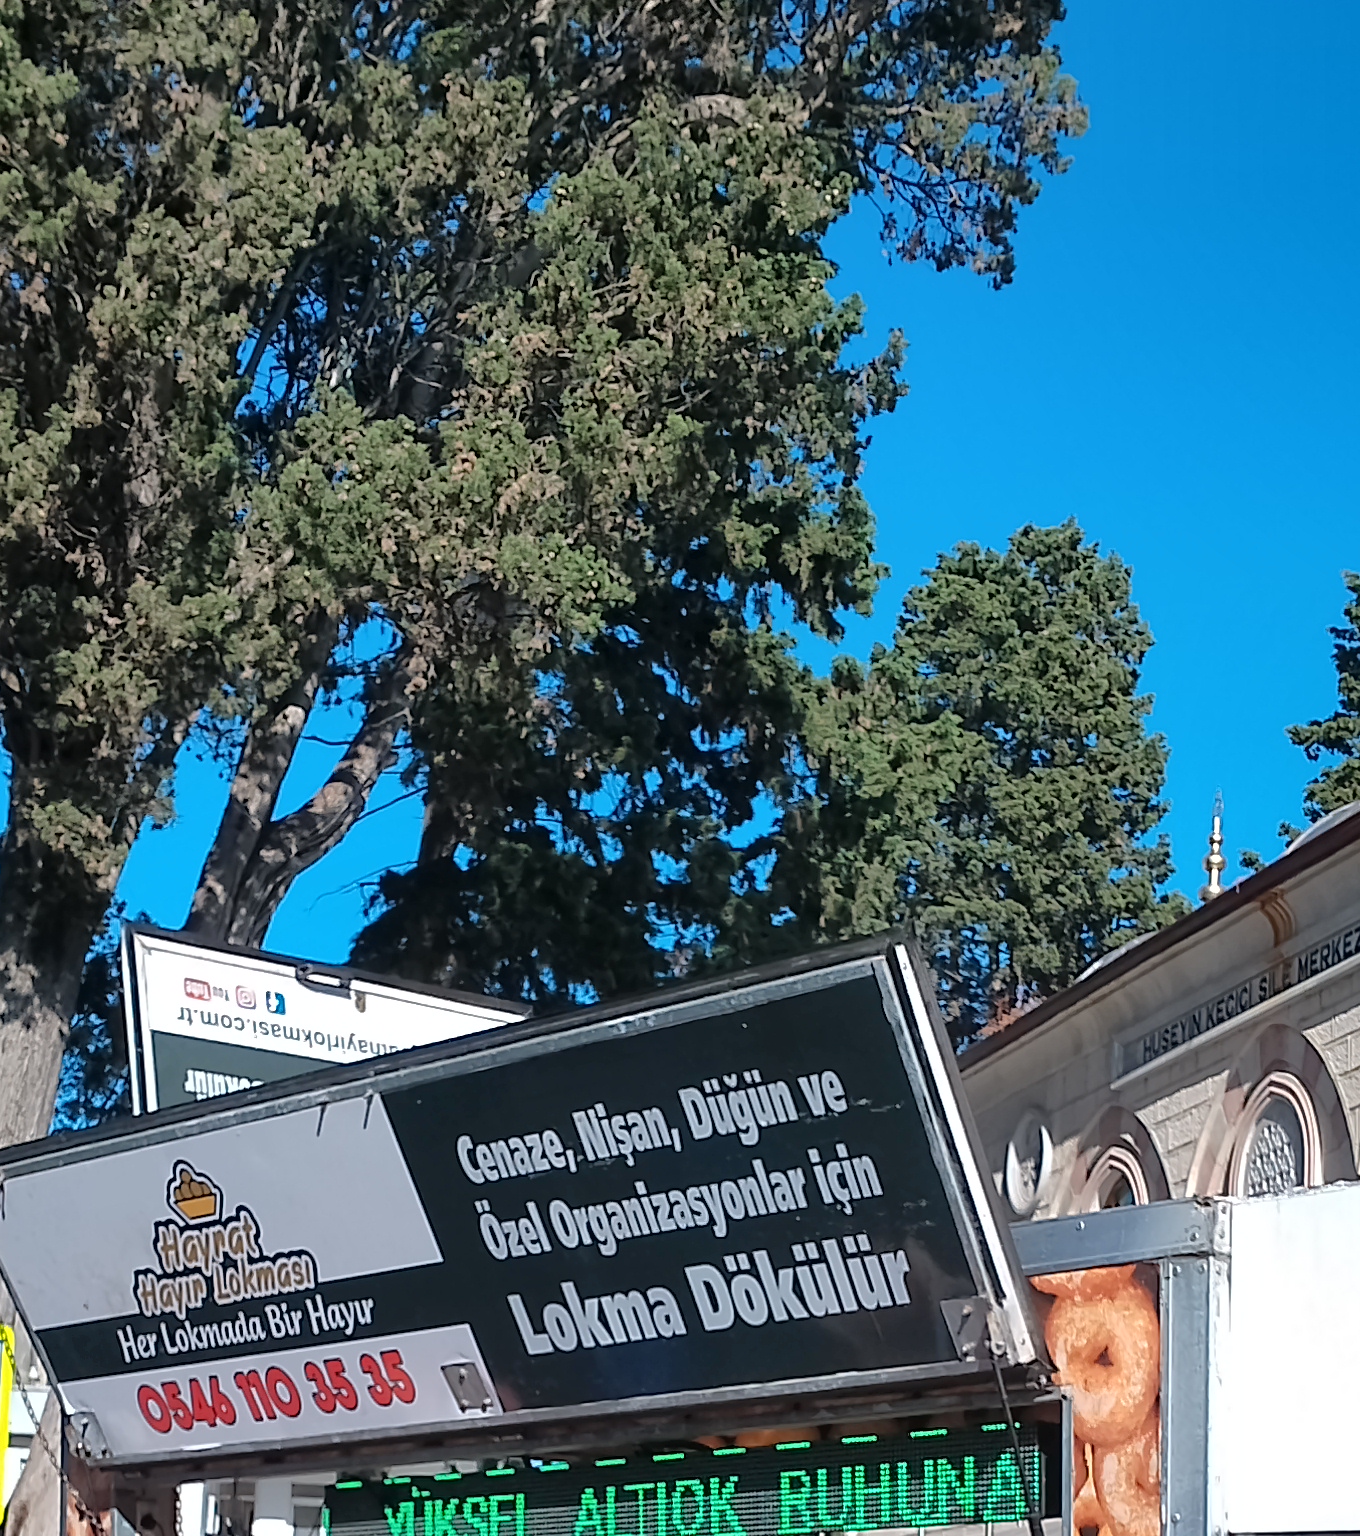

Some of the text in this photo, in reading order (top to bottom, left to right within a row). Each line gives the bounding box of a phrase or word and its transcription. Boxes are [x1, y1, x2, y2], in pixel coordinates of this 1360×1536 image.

[456, 1069, 847, 1184] Cenaze, Nişan, Düğün ve
[157, 1208, 259, 1272] Hayrat
[474, 1144, 883, 1261] Özel Organizasyonlar için
[213, 1253, 316, 1304] Lokması
[507, 1234, 911, 1355] Lokma Dökülür
[117, 1293, 375, 1363] Her Lokmada Bir Hayır
[137, 1349, 416, 1433] 0546 110 35 35
[776, 1448, 1030, 1536] RUHUNA
